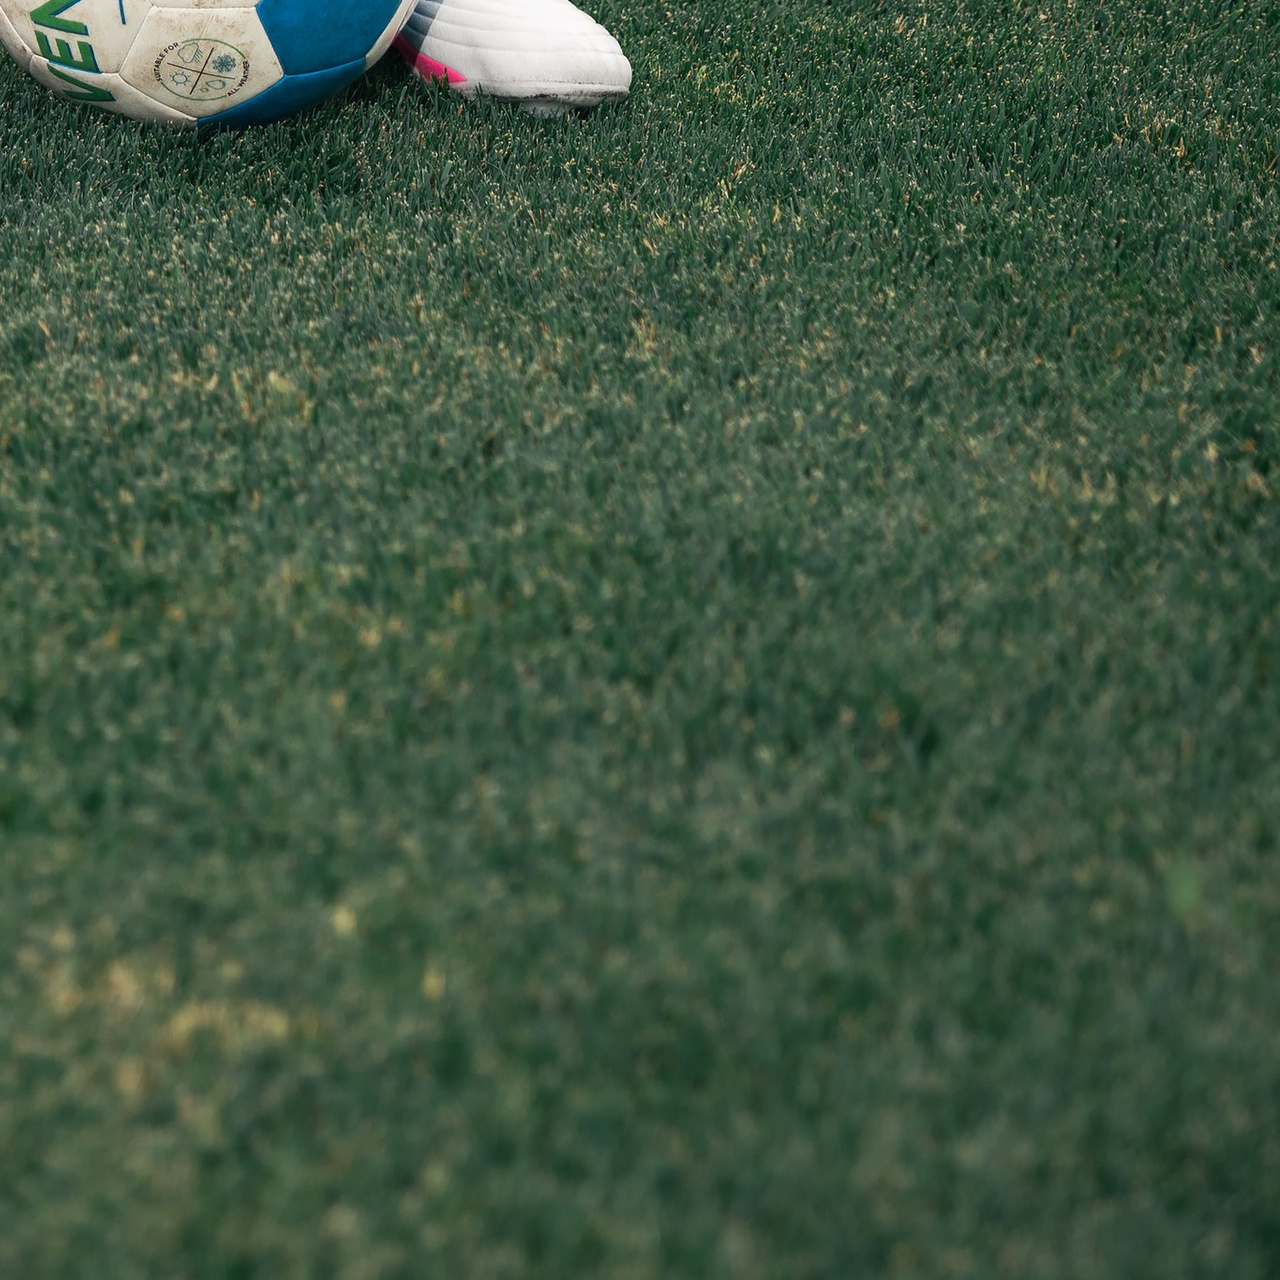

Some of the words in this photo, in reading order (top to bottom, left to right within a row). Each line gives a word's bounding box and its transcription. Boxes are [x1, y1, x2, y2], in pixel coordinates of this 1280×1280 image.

[154, 53, 166, 82] SUITABLE
[164, 41, 179, 54] FOR
[227, 86, 241, 98] ALL
[238, 60, 251, 88] WEATHER
